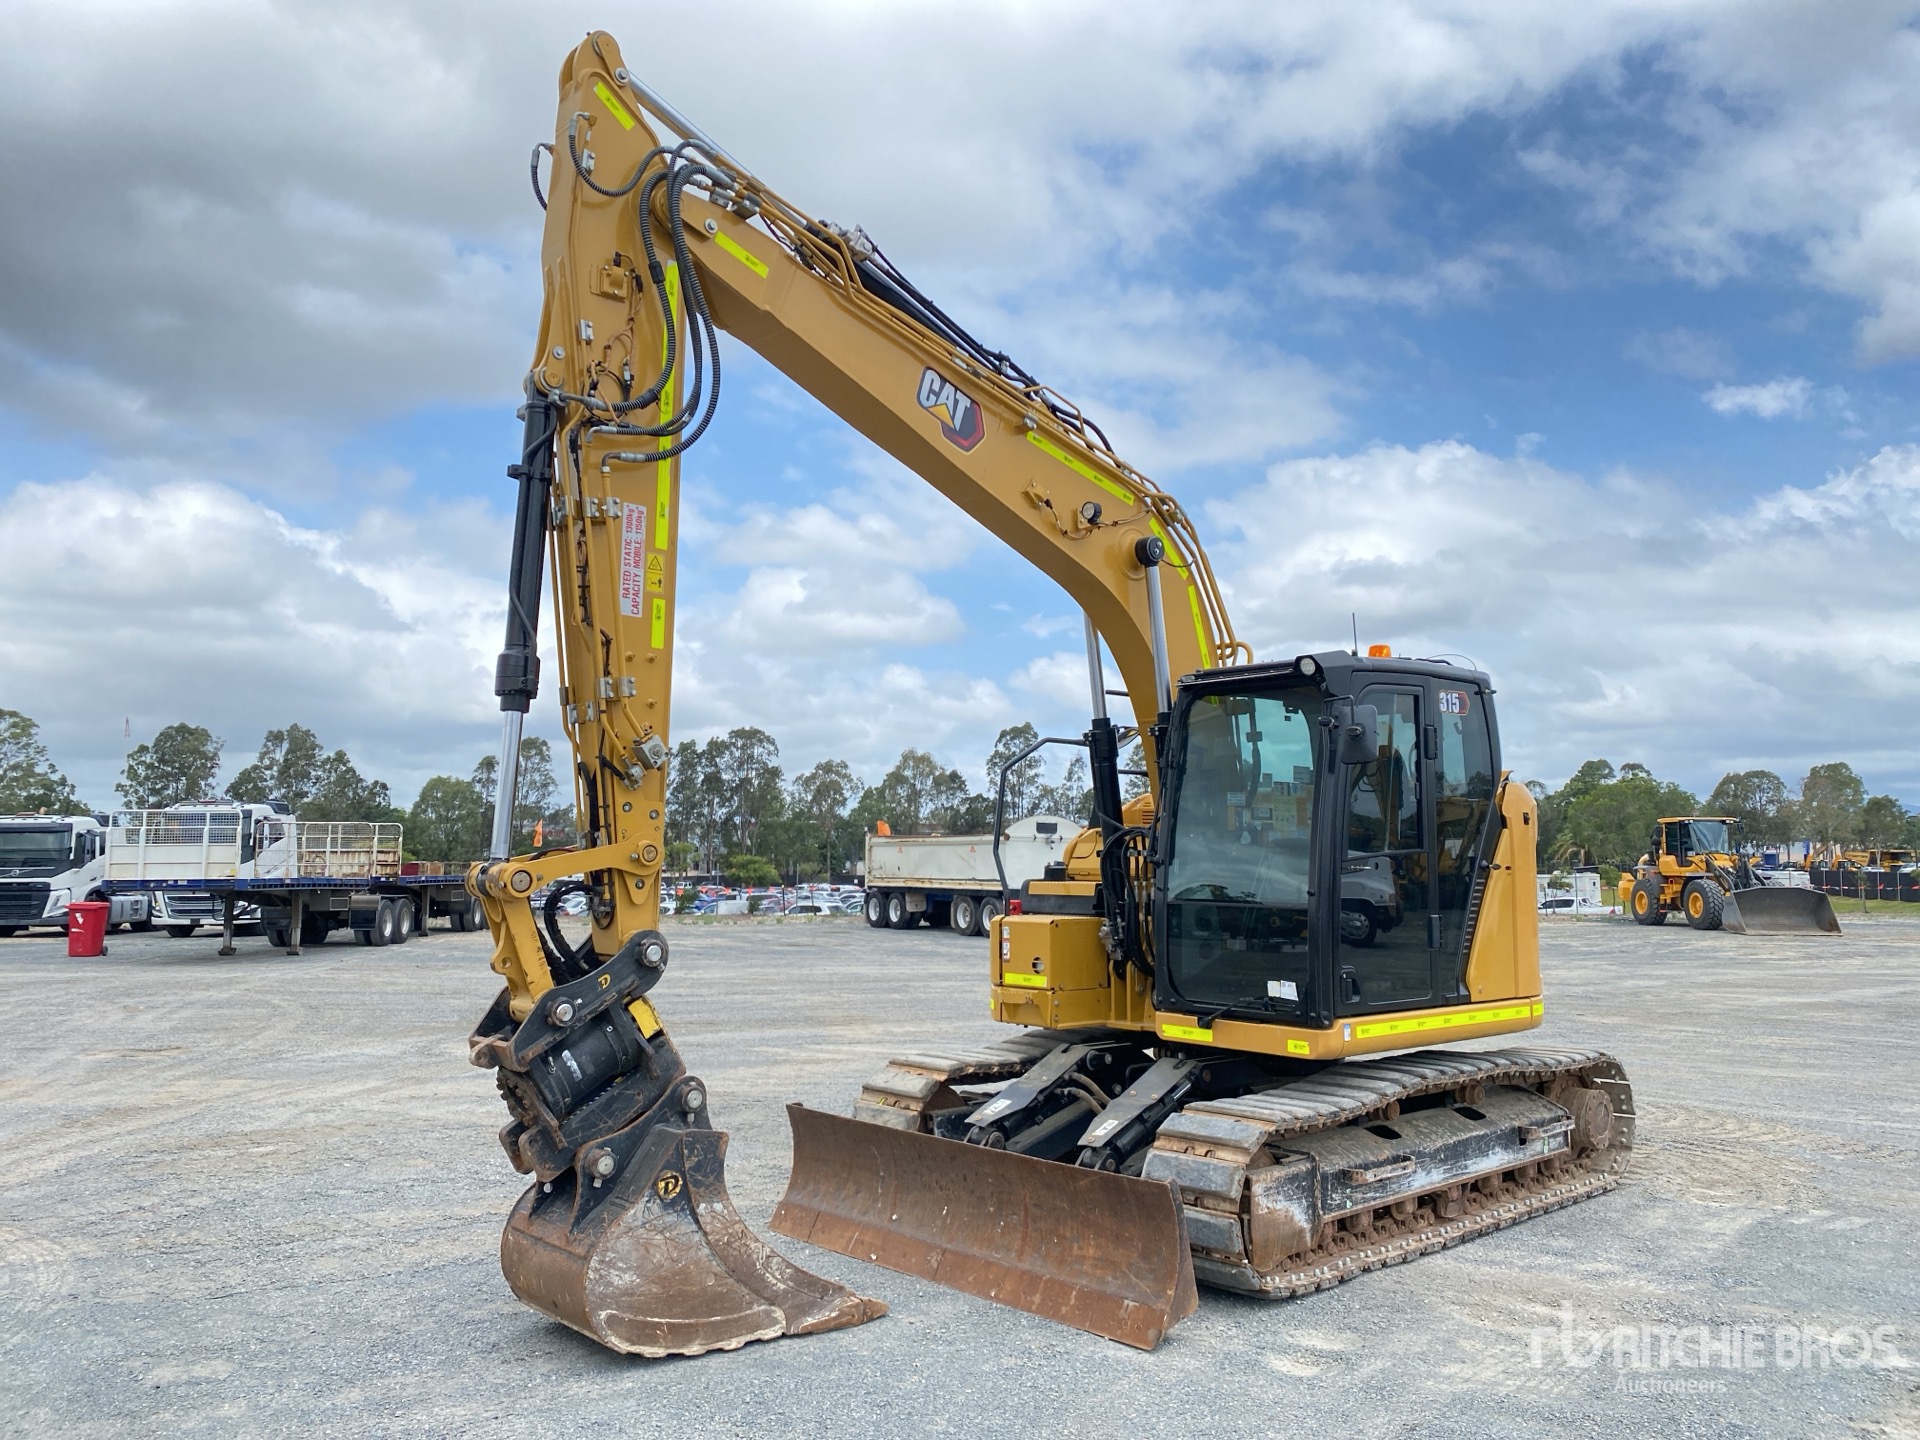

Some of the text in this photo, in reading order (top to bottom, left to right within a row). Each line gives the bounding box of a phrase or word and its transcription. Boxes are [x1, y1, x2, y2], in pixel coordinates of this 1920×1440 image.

[920, 369, 972, 431] CAT
[624, 536, 633, 567] STATIC:
[633, 537, 642, 569] MOBILE:
[622, 570, 632, 599] RATED
[631, 572, 641, 615] CAPACITY
[1439, 691, 1460, 713] 315
